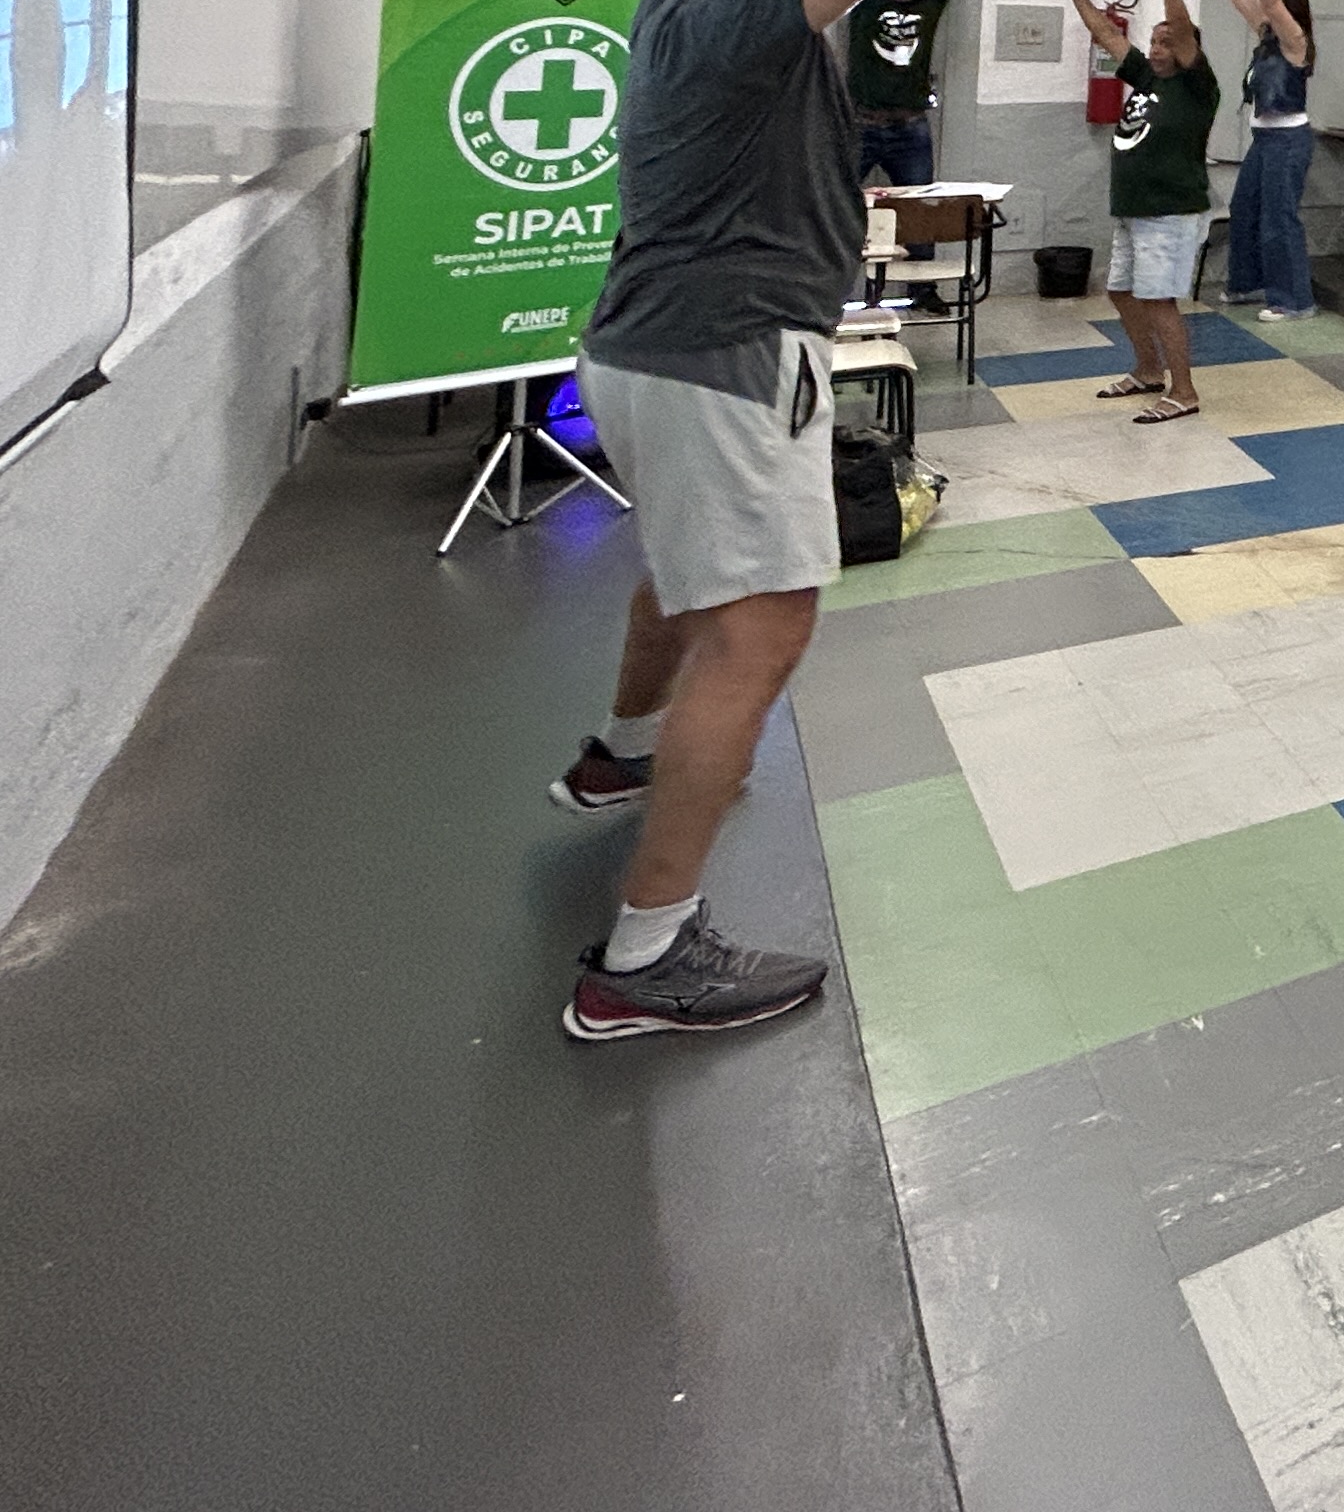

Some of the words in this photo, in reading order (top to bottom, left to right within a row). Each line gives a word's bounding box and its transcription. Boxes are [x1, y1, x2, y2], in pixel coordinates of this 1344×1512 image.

[509, 29, 610, 58] CIPA
[474, 203, 613, 245] SIPAT
[501, 306, 571, 333] FUNEPE
